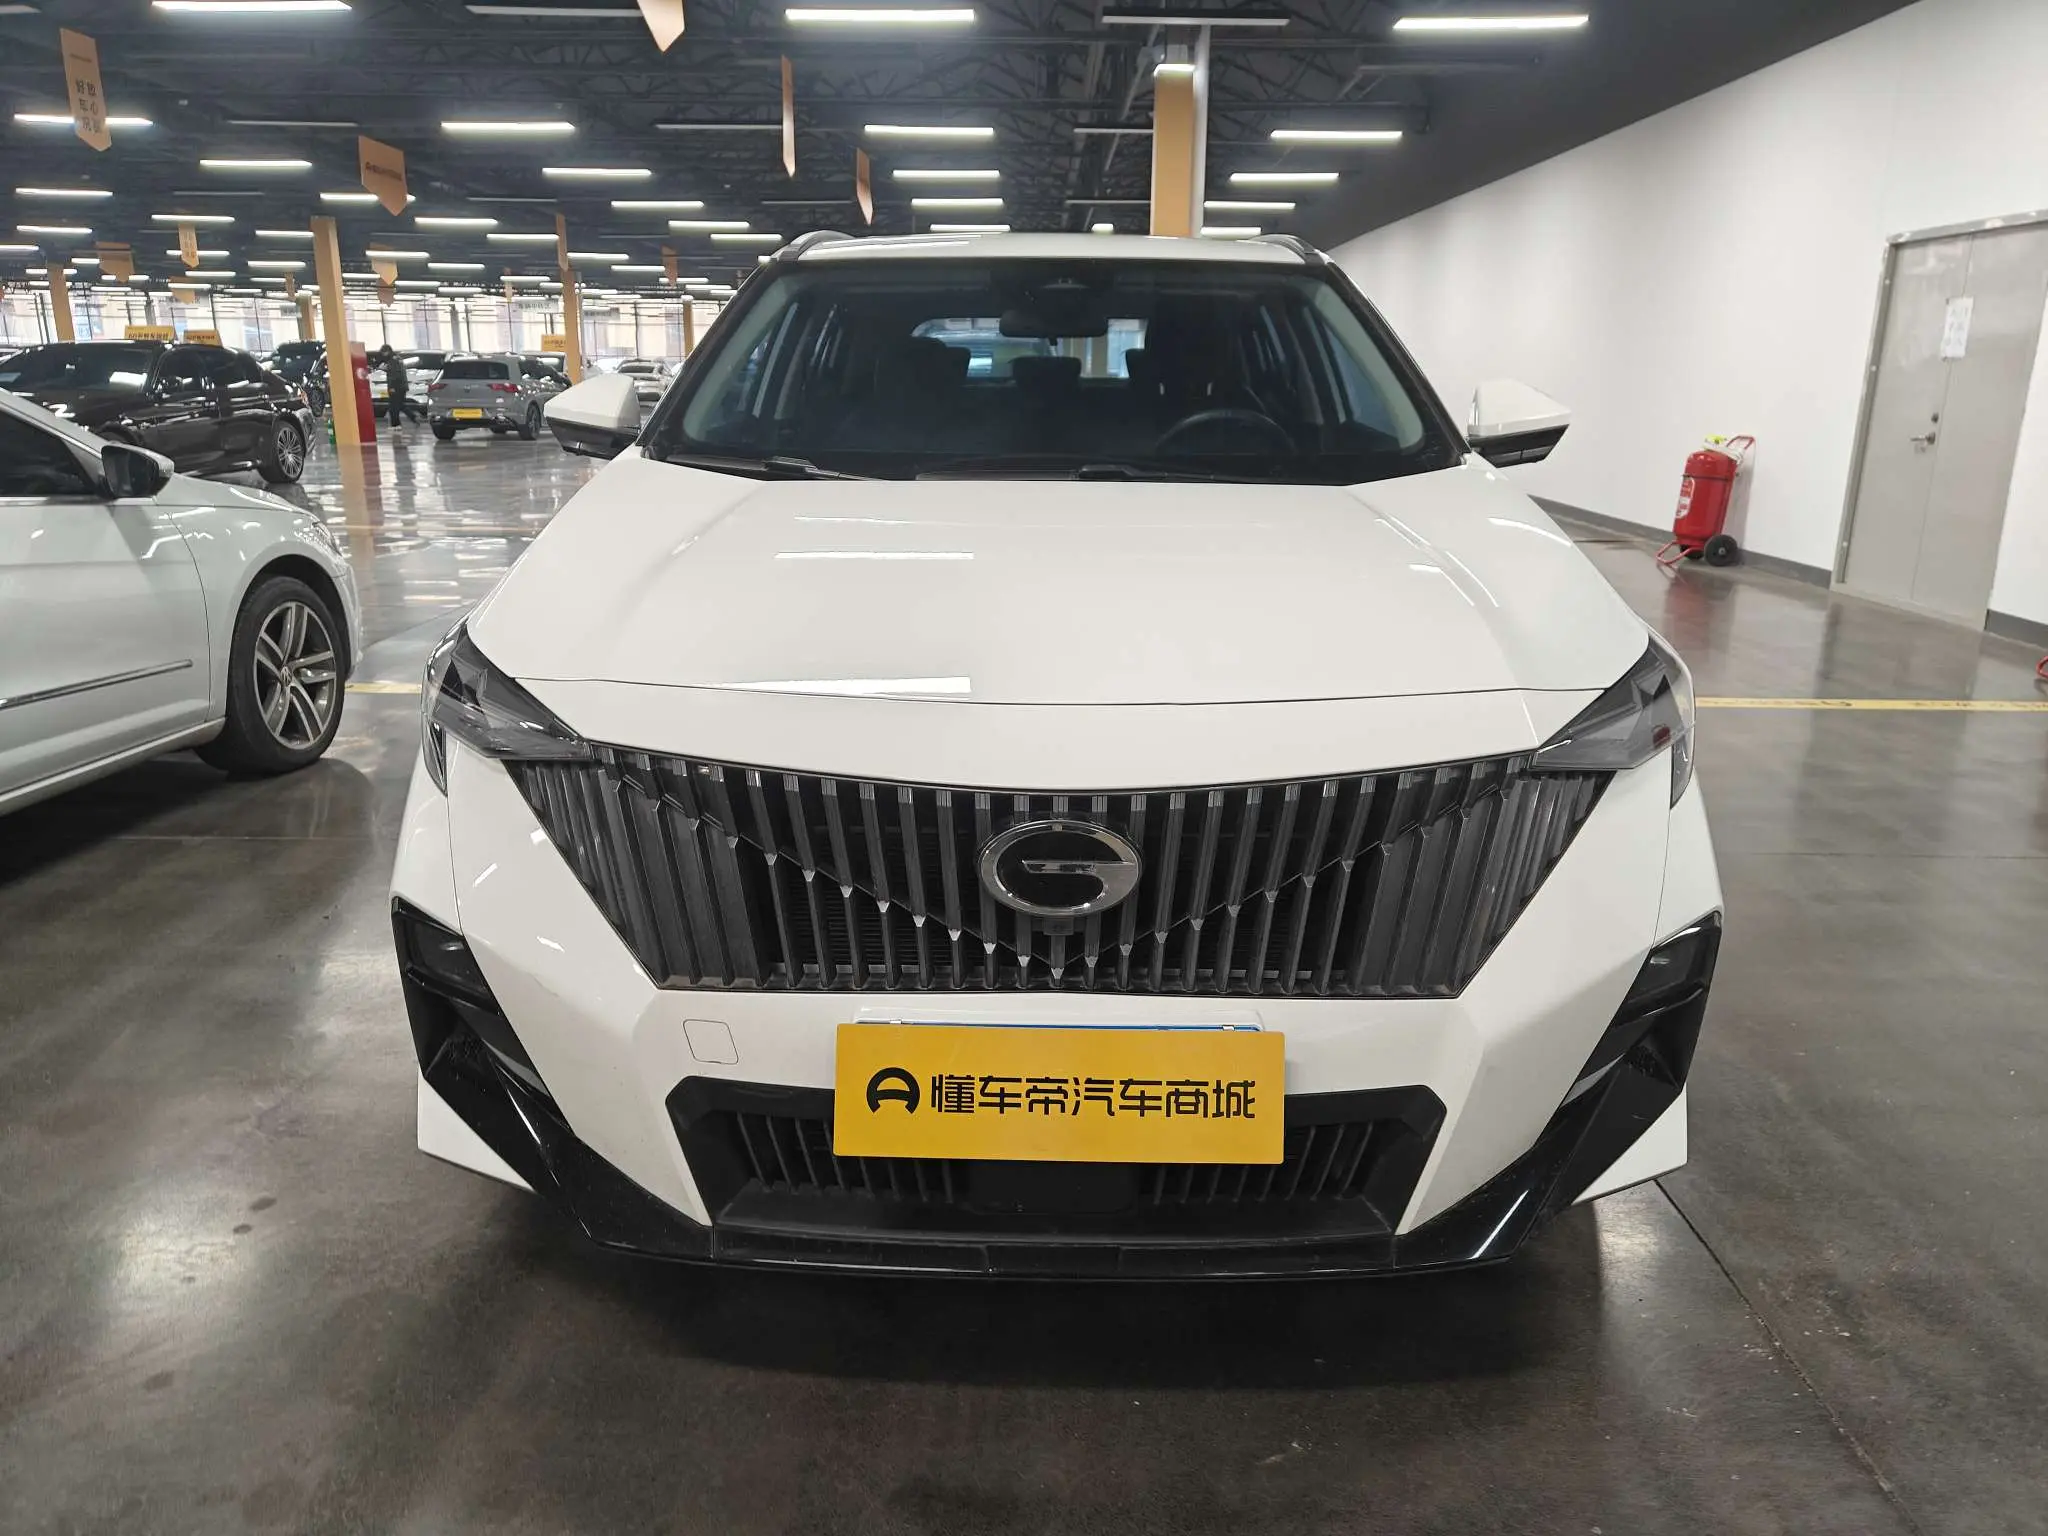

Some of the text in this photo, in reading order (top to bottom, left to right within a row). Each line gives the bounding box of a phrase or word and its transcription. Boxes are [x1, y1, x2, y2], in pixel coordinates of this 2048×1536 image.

[930, 1074, 1256, 1118] 懂车帝汽车商城
